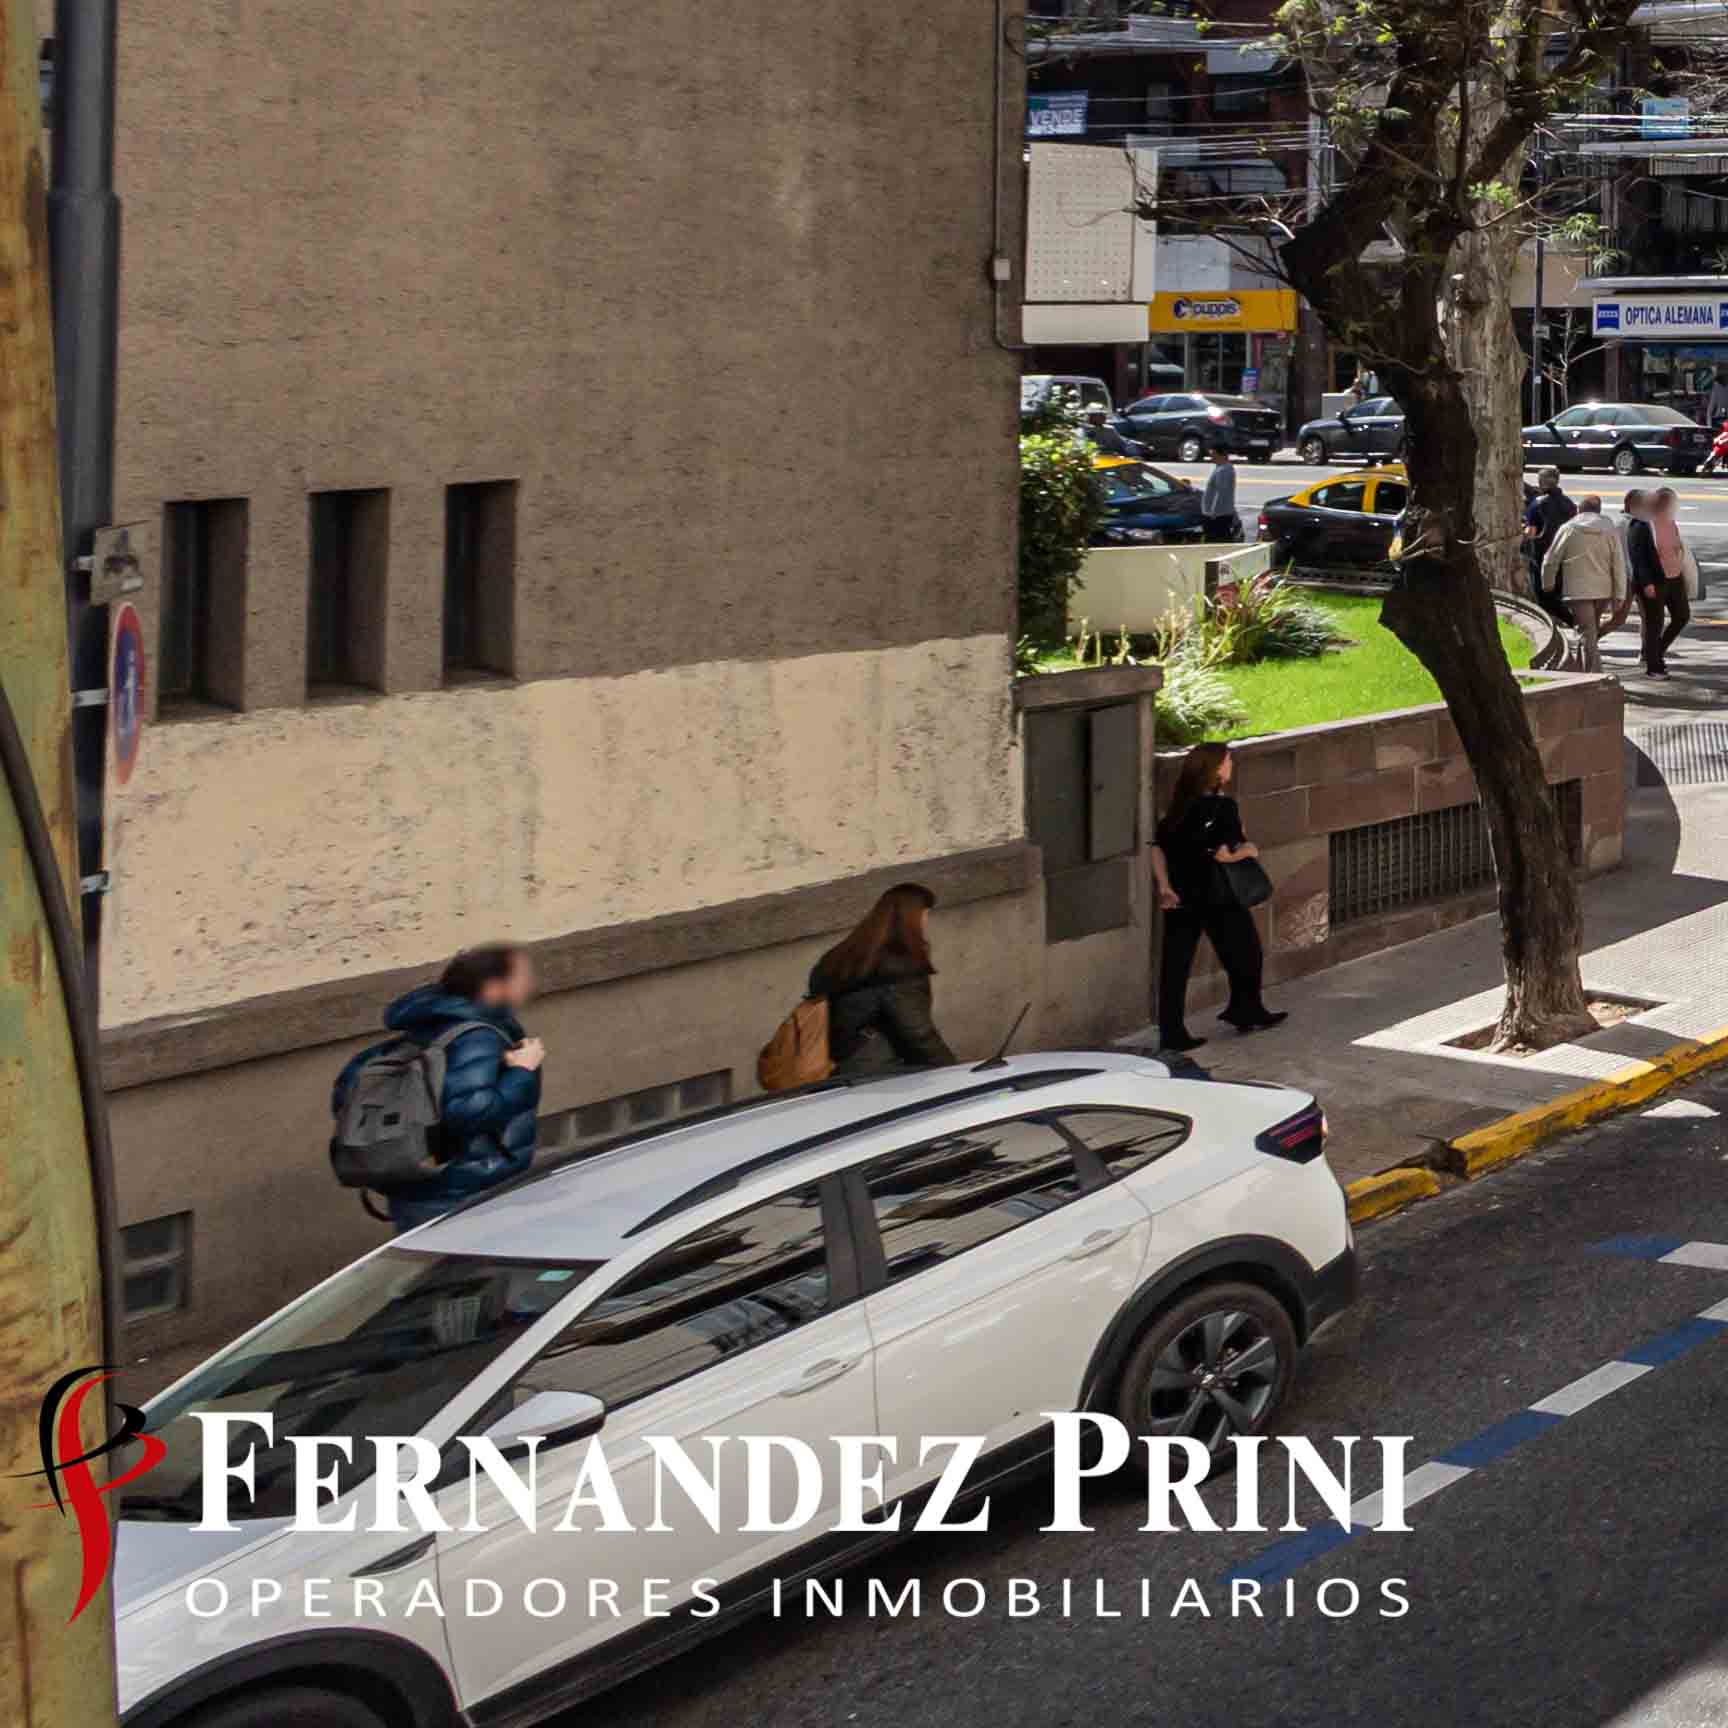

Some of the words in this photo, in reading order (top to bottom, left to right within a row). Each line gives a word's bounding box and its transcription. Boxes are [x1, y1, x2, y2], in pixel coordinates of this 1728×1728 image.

[1030, 109, 1083, 127] VENDE
[1625, 306, 1662, 325] OPTICA
[1664, 304, 1714, 324] ALEMANA
